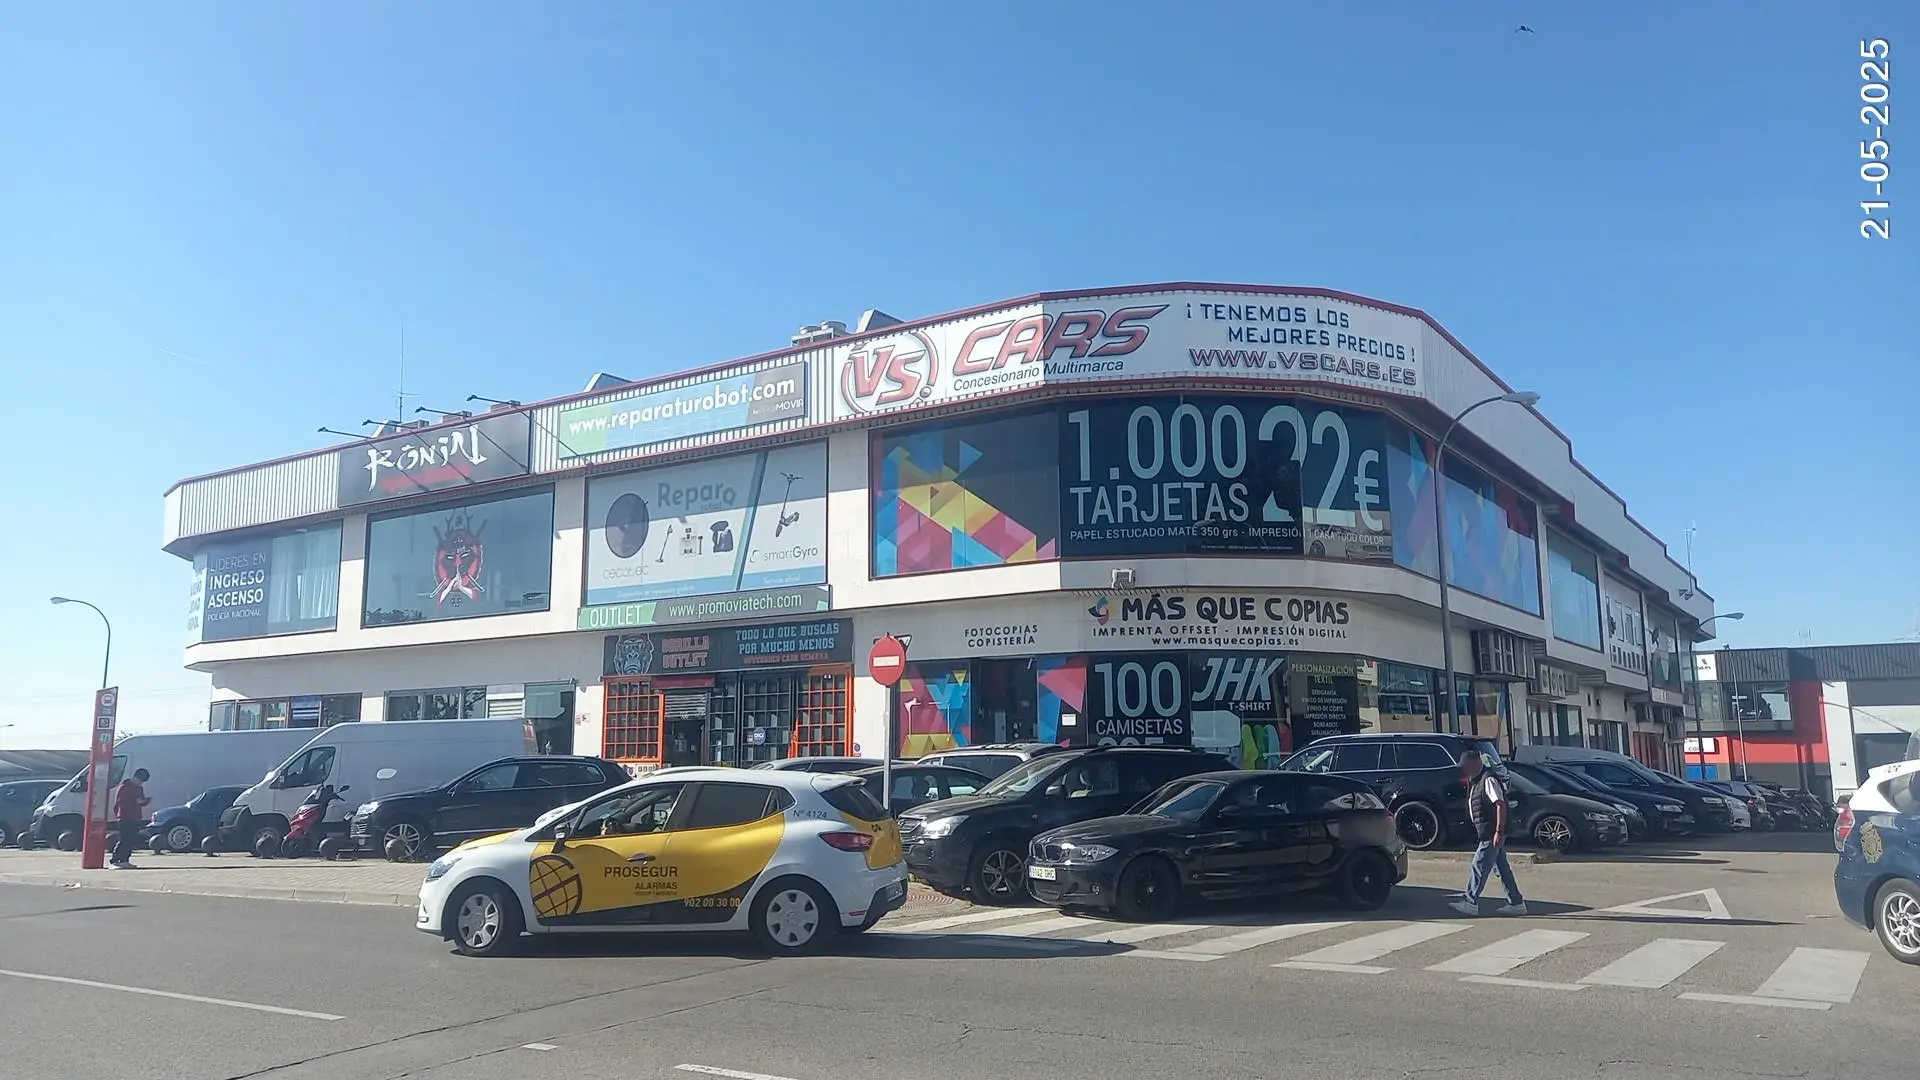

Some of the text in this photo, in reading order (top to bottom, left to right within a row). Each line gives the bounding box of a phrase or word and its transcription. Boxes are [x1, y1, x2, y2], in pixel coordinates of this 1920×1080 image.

[1316, 308, 1350, 328] LOS
[952, 304, 1171, 376] CARS
[1228, 327, 1330, 346] MEJORES
[953, 359, 1124, 391] Concesionario Multimarca
[1189, 348, 1417, 386] WWW.VSCARS.ES
[569, 376, 796, 436] www.reparaturobot.com
[1068, 403, 1247, 481] 1.000
[1069, 482, 1249, 524] TARJETAS
[1070, 530, 1104, 540] PAPEL
[1106, 527, 1164, 539] ESTUCADO
[1168, 526, 1199, 537] MATE
[1201, 527, 1220, 537] 350
[1222, 528, 1239, 539] grs
[1359, 534, 1384, 545] COLOR
[252, 552, 266, 567] EN
[209, 569, 265, 590] INGRESO
[207, 588, 264, 609] ASCENSO
[589, 604, 643, 628] OUTLET
[669, 592, 802, 618] www.promoviatech.com
[1121, 592, 1350, 625] MÁS QUE COPIAS
[736, 622, 839, 641] TODO LO QUE BUSCAS
[965, 624, 1038, 637] FOTOCOPIAS
[1093, 626, 1163, 637] IMPRENTA
[1169, 625, 1218, 636] OFFSET
[1236, 624, 1305, 636] IMPRESIÓN
[1309, 628, 1347, 639] DIGITAL
[739, 637, 834, 654] POR MUCHO MENOS
[968, 635, 1035, 648] COPISTERÍA
[1152, 636, 1300, 647] www.masquecopias.es
[1292, 663, 1354, 674] PERSONALIZACIÓN
[1192, 657, 1286, 702] JHK
[1094, 661, 1182, 718] 100
[1228, 702, 1271, 711] T-SHIRT
[1096, 719, 1183, 734] CAMISETAS
[604, 866, 678, 878] PROSEGUR
[634, 881, 678, 890] ALARMAS
